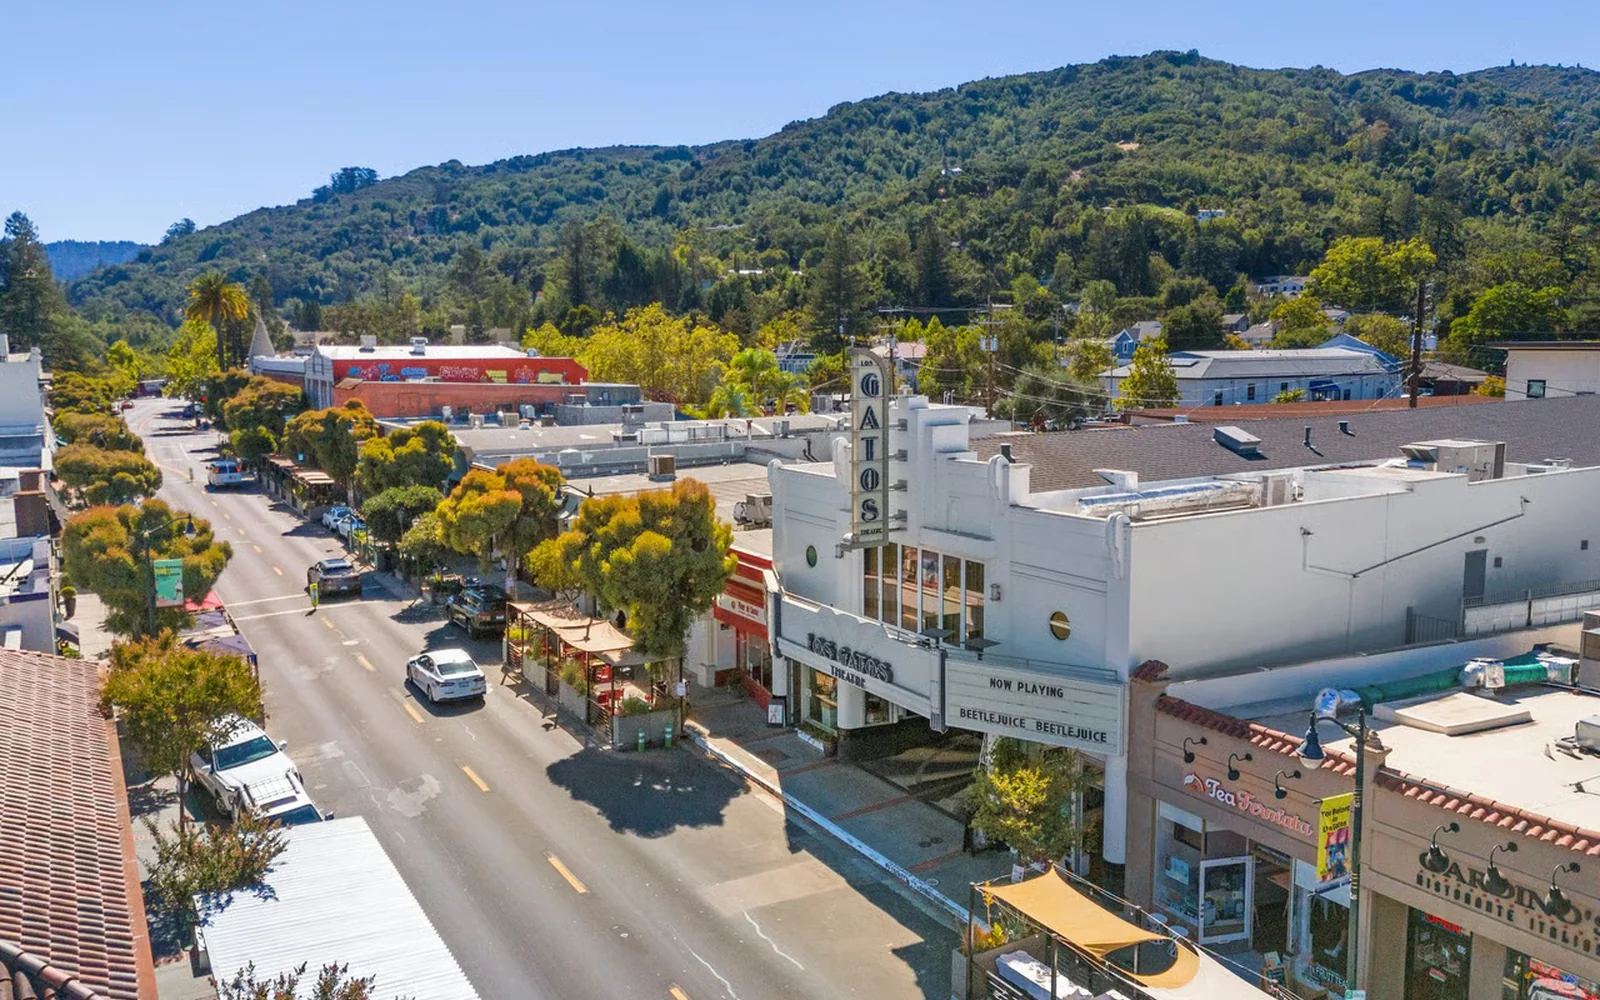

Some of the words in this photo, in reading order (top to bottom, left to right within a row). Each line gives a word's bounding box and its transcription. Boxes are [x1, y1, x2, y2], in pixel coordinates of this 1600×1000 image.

[860, 373, 880, 523] GATOS
[829, 664, 867, 689] THEATRE
[838, 646, 894, 684] GATOS
[989, 677, 1012, 691] NOW
[1017, 681, 1064, 698] PLAYING
[959, 708, 1026, 729] BEETLEJUICE
[1036, 721, 1107, 743] BEETLEJUICE
[1205, 778, 1236, 807] Tea
[1416, 873, 1515, 921] RISTORANTE
[1424, 912, 1463, 935] OPEN
